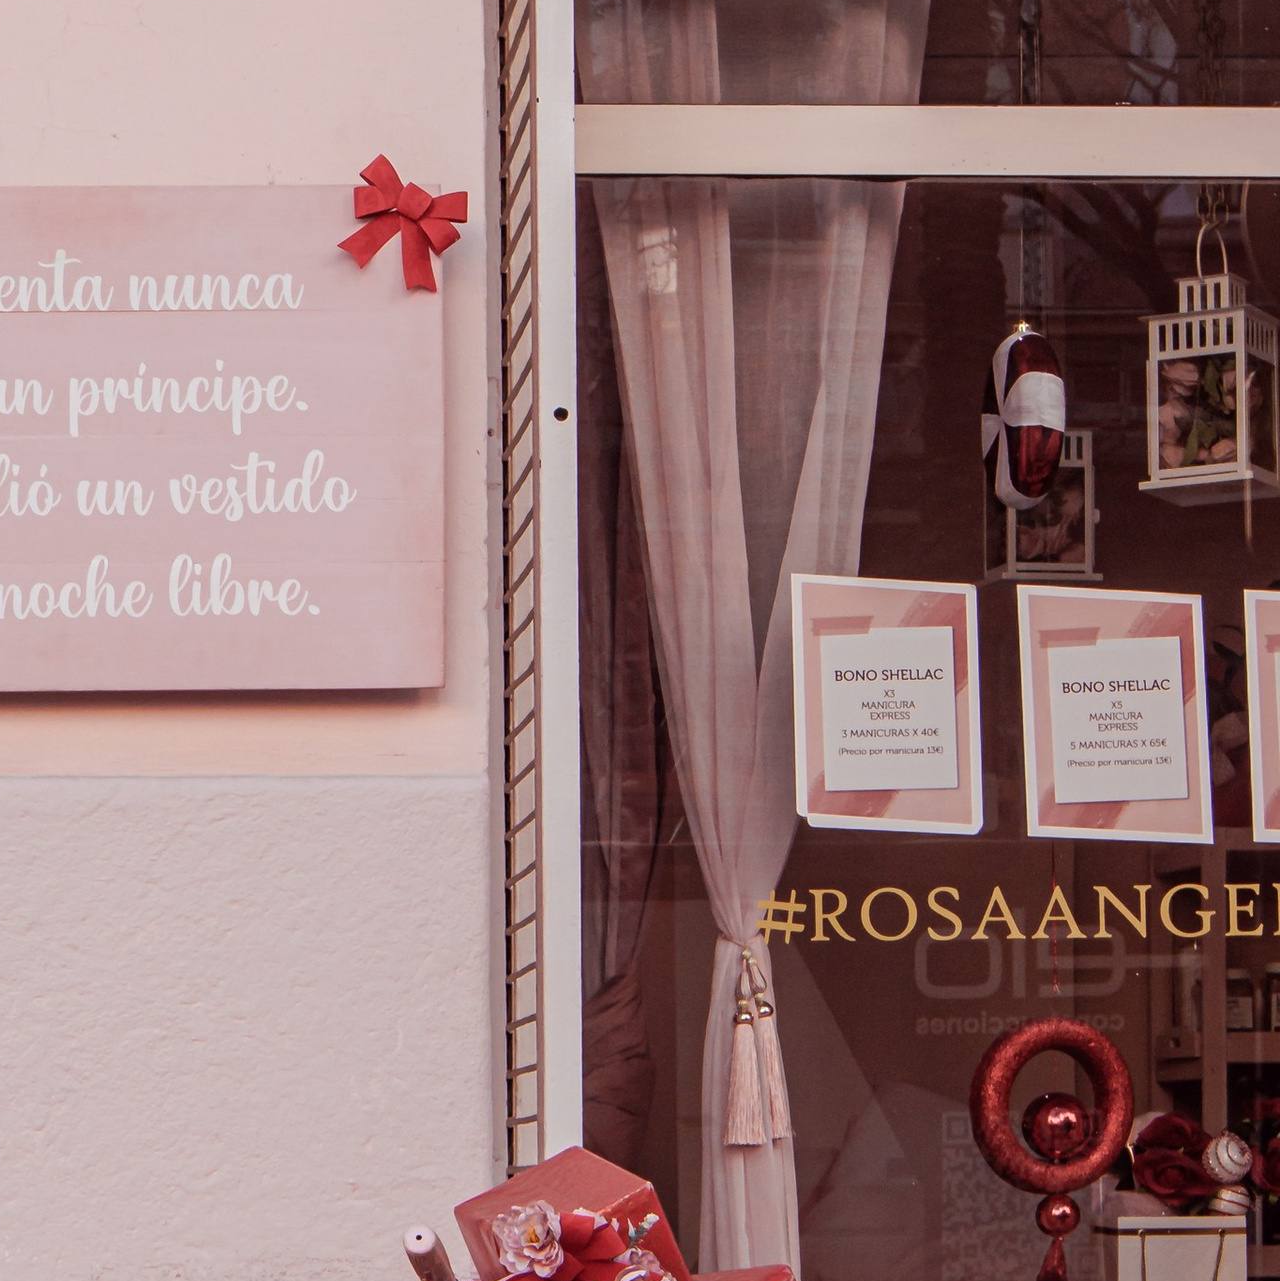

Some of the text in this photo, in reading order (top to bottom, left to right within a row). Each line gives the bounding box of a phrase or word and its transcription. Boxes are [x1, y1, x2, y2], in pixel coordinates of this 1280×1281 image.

[129, 273, 305, 311] nunca
[69, 359, 309, 437] príncipe.
[77, 480, 155, 516] un
[169, 449, 358, 522] vestido
[169, 553, 321, 616] libre.
[834, 669, 944, 681] BONO SHELLAC
[1062, 679, 1171, 693] BONO SHELLAC
[884, 690, 895, 698] X3
[861, 701, 916, 709] MANICURA
[1111, 701, 1123, 709] X5
[870, 711, 910, 720] EXPRESS
[1089, 712, 1143, 721] MANICURA
[1098, 723, 1138, 732] EXPRESS
[842, 728, 939, 738] 3 MANICURAS X 40€
[1070, 742, 1076, 750] 5
[1079, 740, 1138, 750] MANICURAS
[1150, 739, 1167, 747] 65€
[1098, 759, 1111, 767] por
[1114, 758, 1153, 766] manicura
